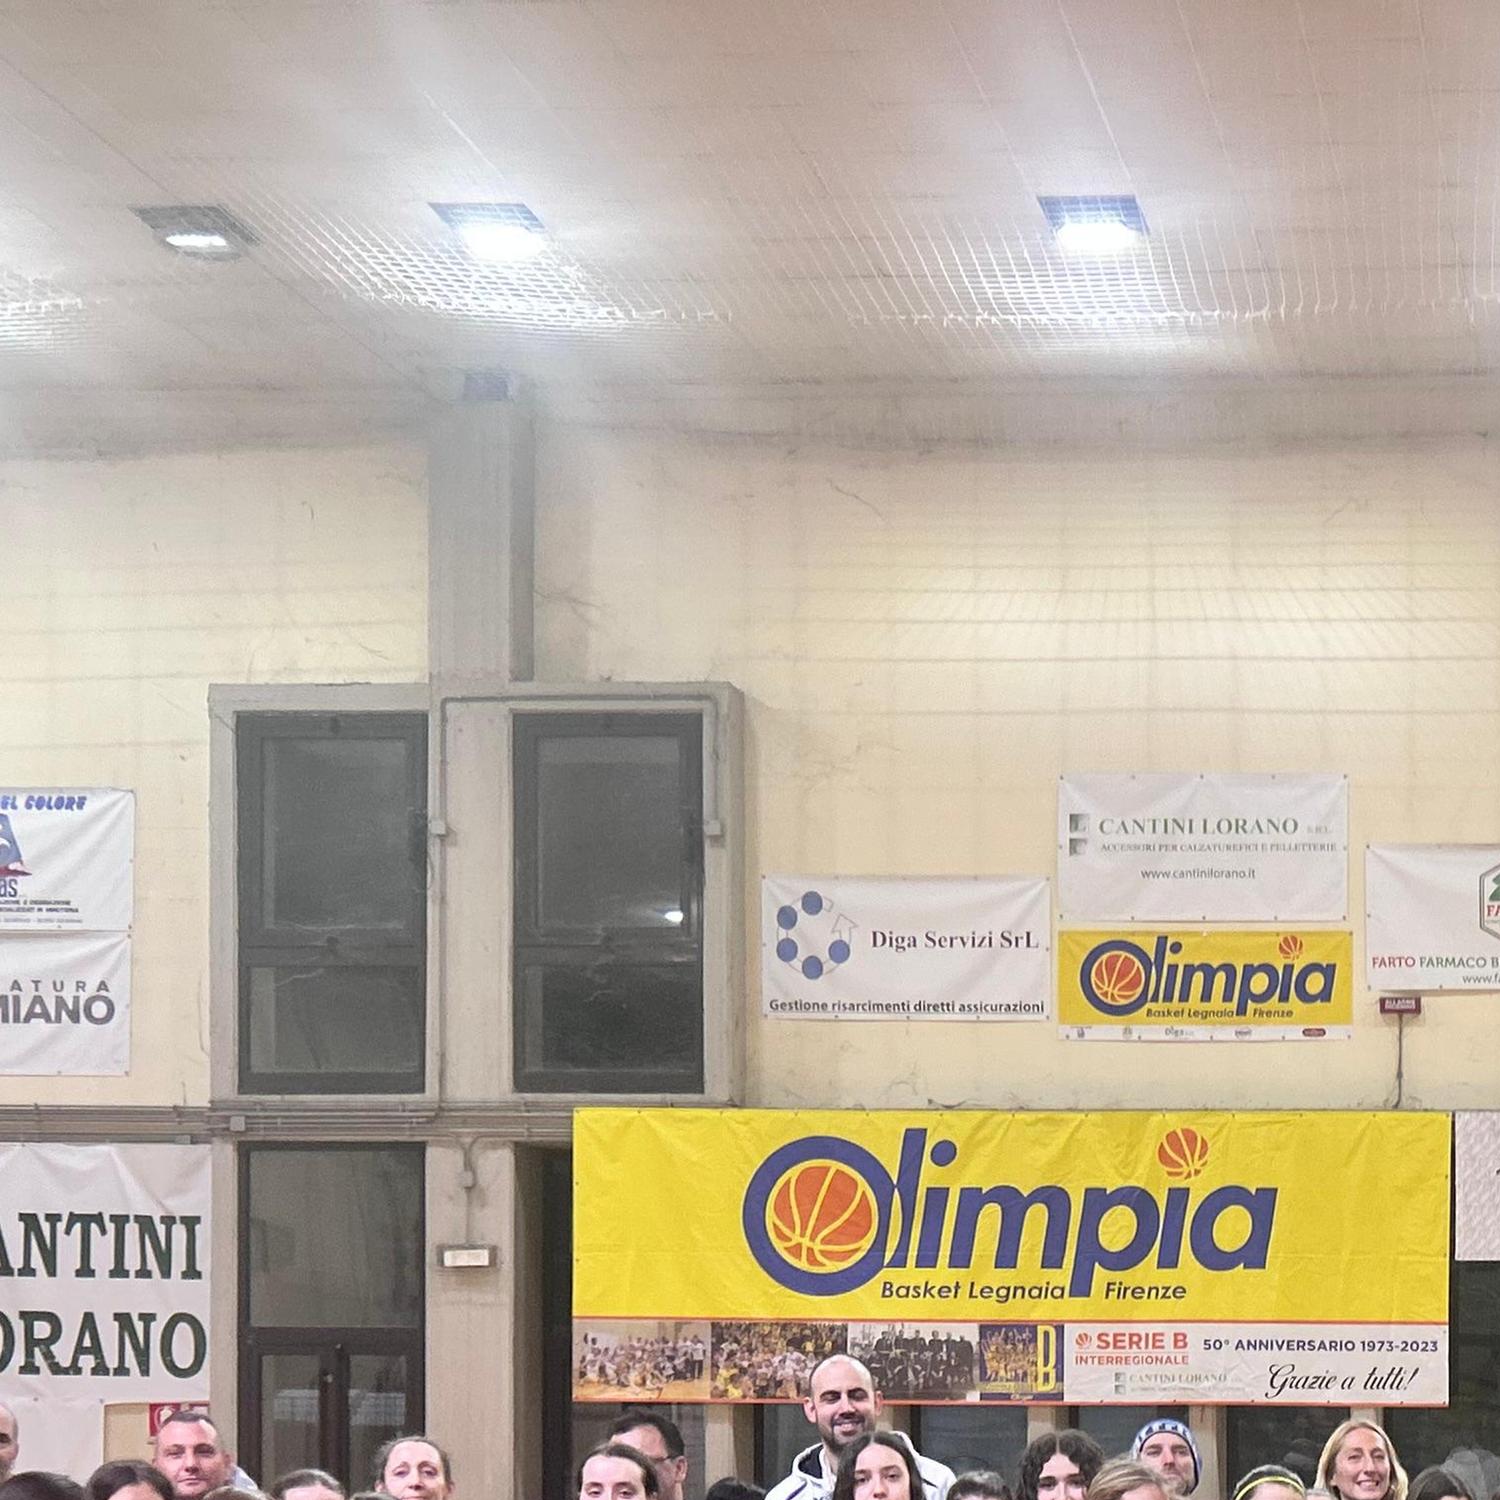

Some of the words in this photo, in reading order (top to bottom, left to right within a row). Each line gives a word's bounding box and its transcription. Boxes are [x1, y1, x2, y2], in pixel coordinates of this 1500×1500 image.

[1099, 818, 1194, 835] CANTINI
[1202, 818, 1300, 835] LORANO
[1100, 843, 1157, 852] ACCESSORI
[1158, 843, 1178, 852] PER
[1261, 843, 1269, 851] E
[1270, 842, 1337, 851] PELLETTERIE
[1140, 867, 1256, 880] www.cantinilorano.it
[871, 931, 918, 951] Diga
[924, 930, 993, 949] Servizi
[1000, 930, 1039, 949] SrL
[1371, 956, 1416, 969] FARTO
[1419, 956, 1487, 969] FARMACO
[1080, 936, 1337, 1017] Olimpia
[0, 995, 116, 1025] IANO
[769, 998, 829, 1012] Gestione
[831, 999, 911, 1013] risarcimenti
[913, 999, 956, 1013] diretti
[958, 1000, 1045, 1013] assicurazioni
[1146, 1008, 1185, 1018] Basket
[1187, 1008, 1235, 1020] Legnaia
[1253, 1008, 1294, 1018] Firenze
[743, 1128, 1279, 1298] Olimpia
[881, 1281, 961, 1299] Basket
[969, 1281, 1065, 1304] Legnaia
[1105, 1281, 1188, 1300] Firenze
[1097, 1332, 1165, 1350] SERIE
[1173, 1332, 1189, 1350] B
[1203, 1338, 1230, 1352] 50°
[1234, 1338, 1356, 1353] ANNIVERSARIO
[1360, 1339, 1439, 1353] 1973-2023
[1075, 1354, 1189, 1367] INTERREGIONALE
[1265, 1363, 1338, 1399] Grazie
[1340, 1378, 1355, 1391] a
[1363, 1366, 1421, 1392] tutti!
